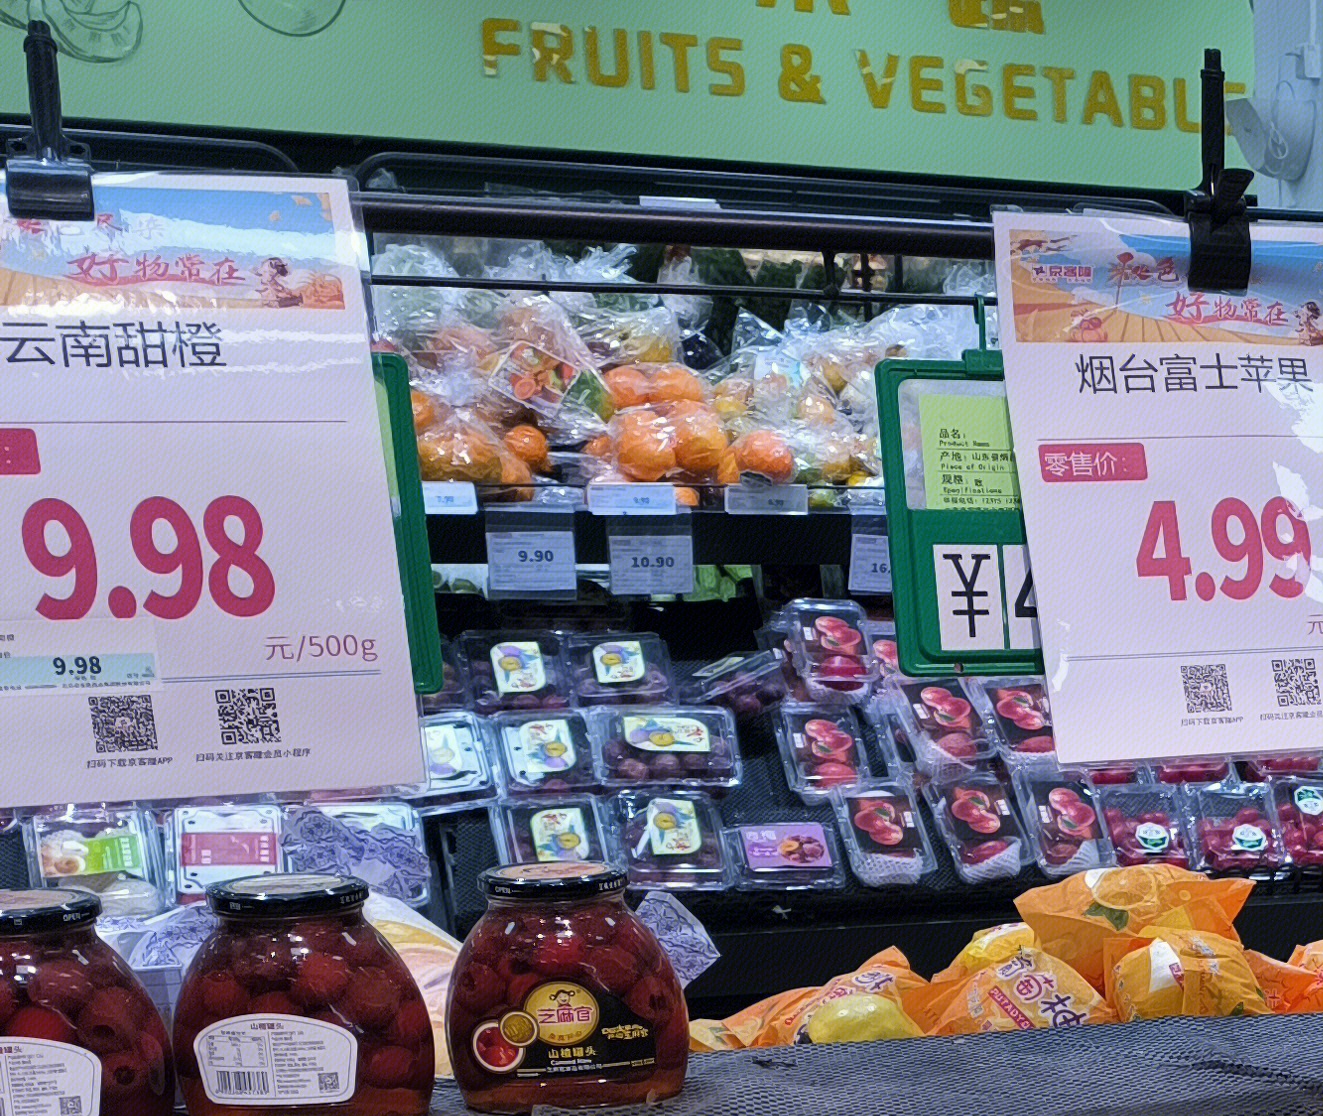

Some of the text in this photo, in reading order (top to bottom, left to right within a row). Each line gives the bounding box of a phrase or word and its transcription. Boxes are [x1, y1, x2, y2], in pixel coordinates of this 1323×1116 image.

[481, 18, 746, 97] FRUITS
[778, 44, 827, 104] &
[65, 253, 245, 287] 好物常在
[1165, 291, 1289, 325] 好物常在
[2, 320, 227, 368] 云南甜橙
[1075, 353, 1314, 394] 烟台富士苹果
[21, 494, 276, 620] 9.98
[517, 550, 554, 562] 9.90
[631, 556, 675, 568] 10.90
[1135, 495, 1312, 601] 4.99
[264, 633, 379, 662] 元/500g
[53, 655, 102, 676] 9.98
[537, 1006, 598, 1024] 芝麻官
